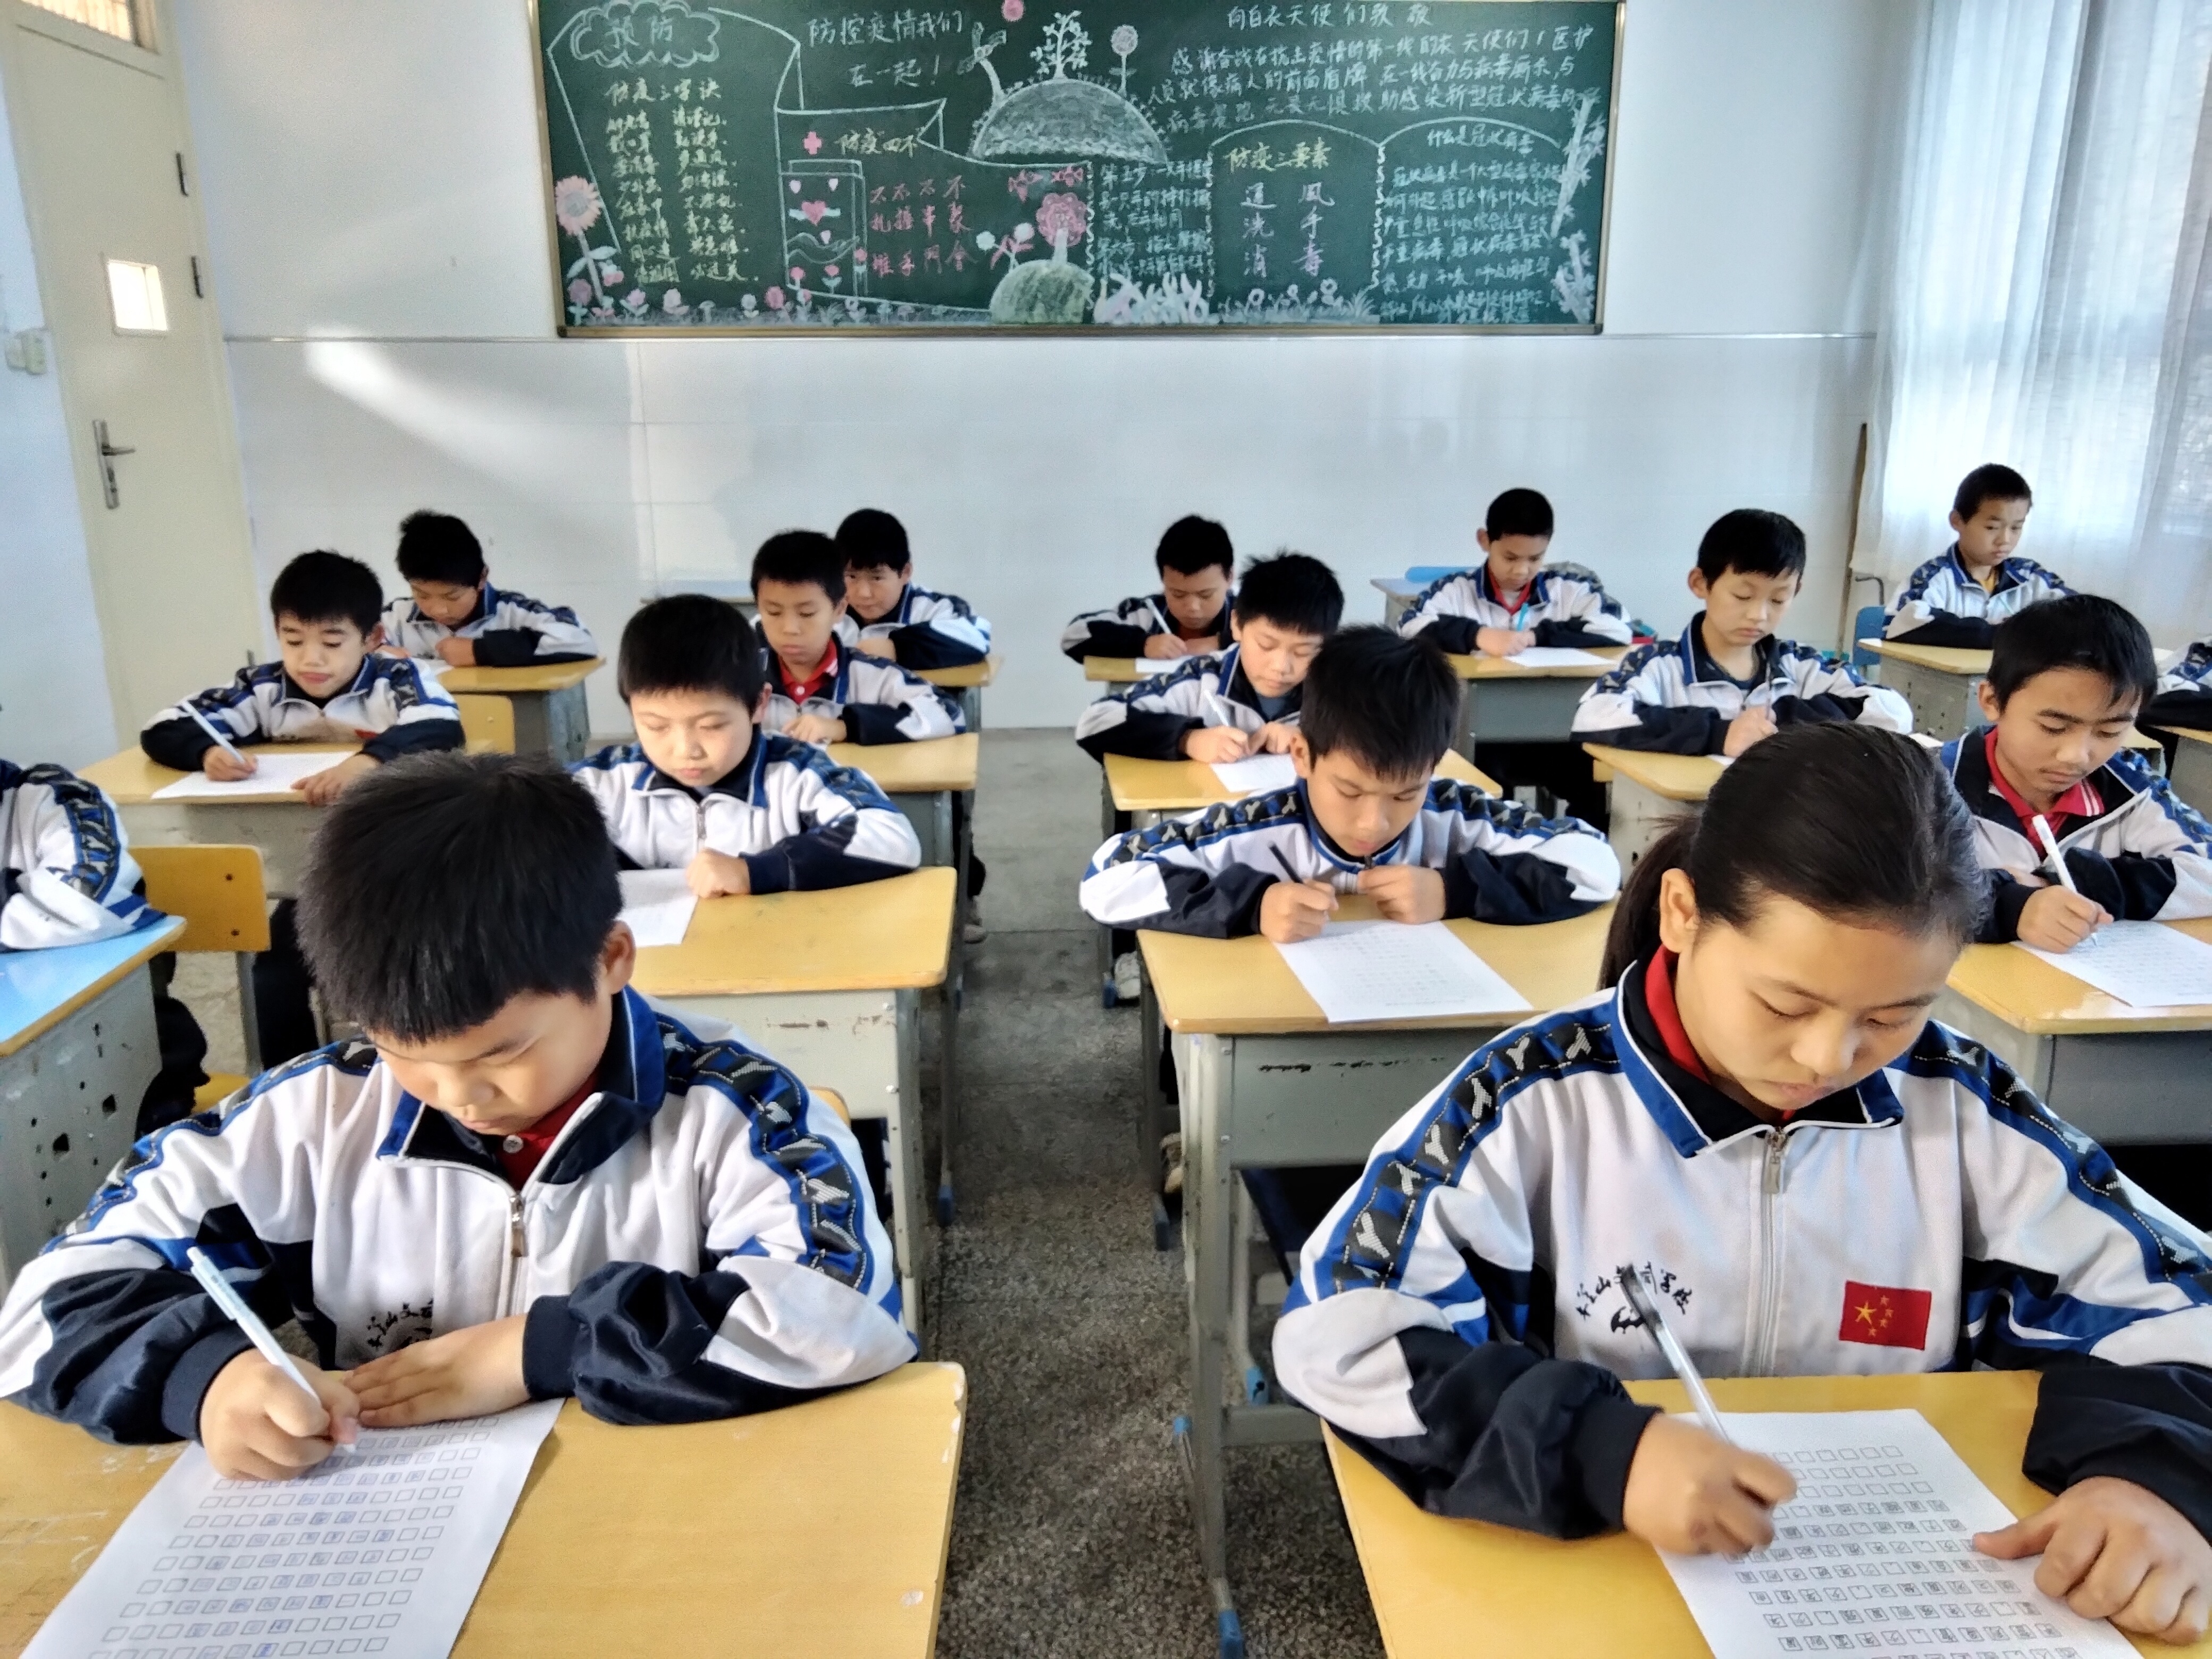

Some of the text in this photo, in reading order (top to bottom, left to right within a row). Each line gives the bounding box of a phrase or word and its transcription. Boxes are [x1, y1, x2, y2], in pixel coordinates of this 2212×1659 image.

[807, 9, 962, 47] 防控疫情我们
